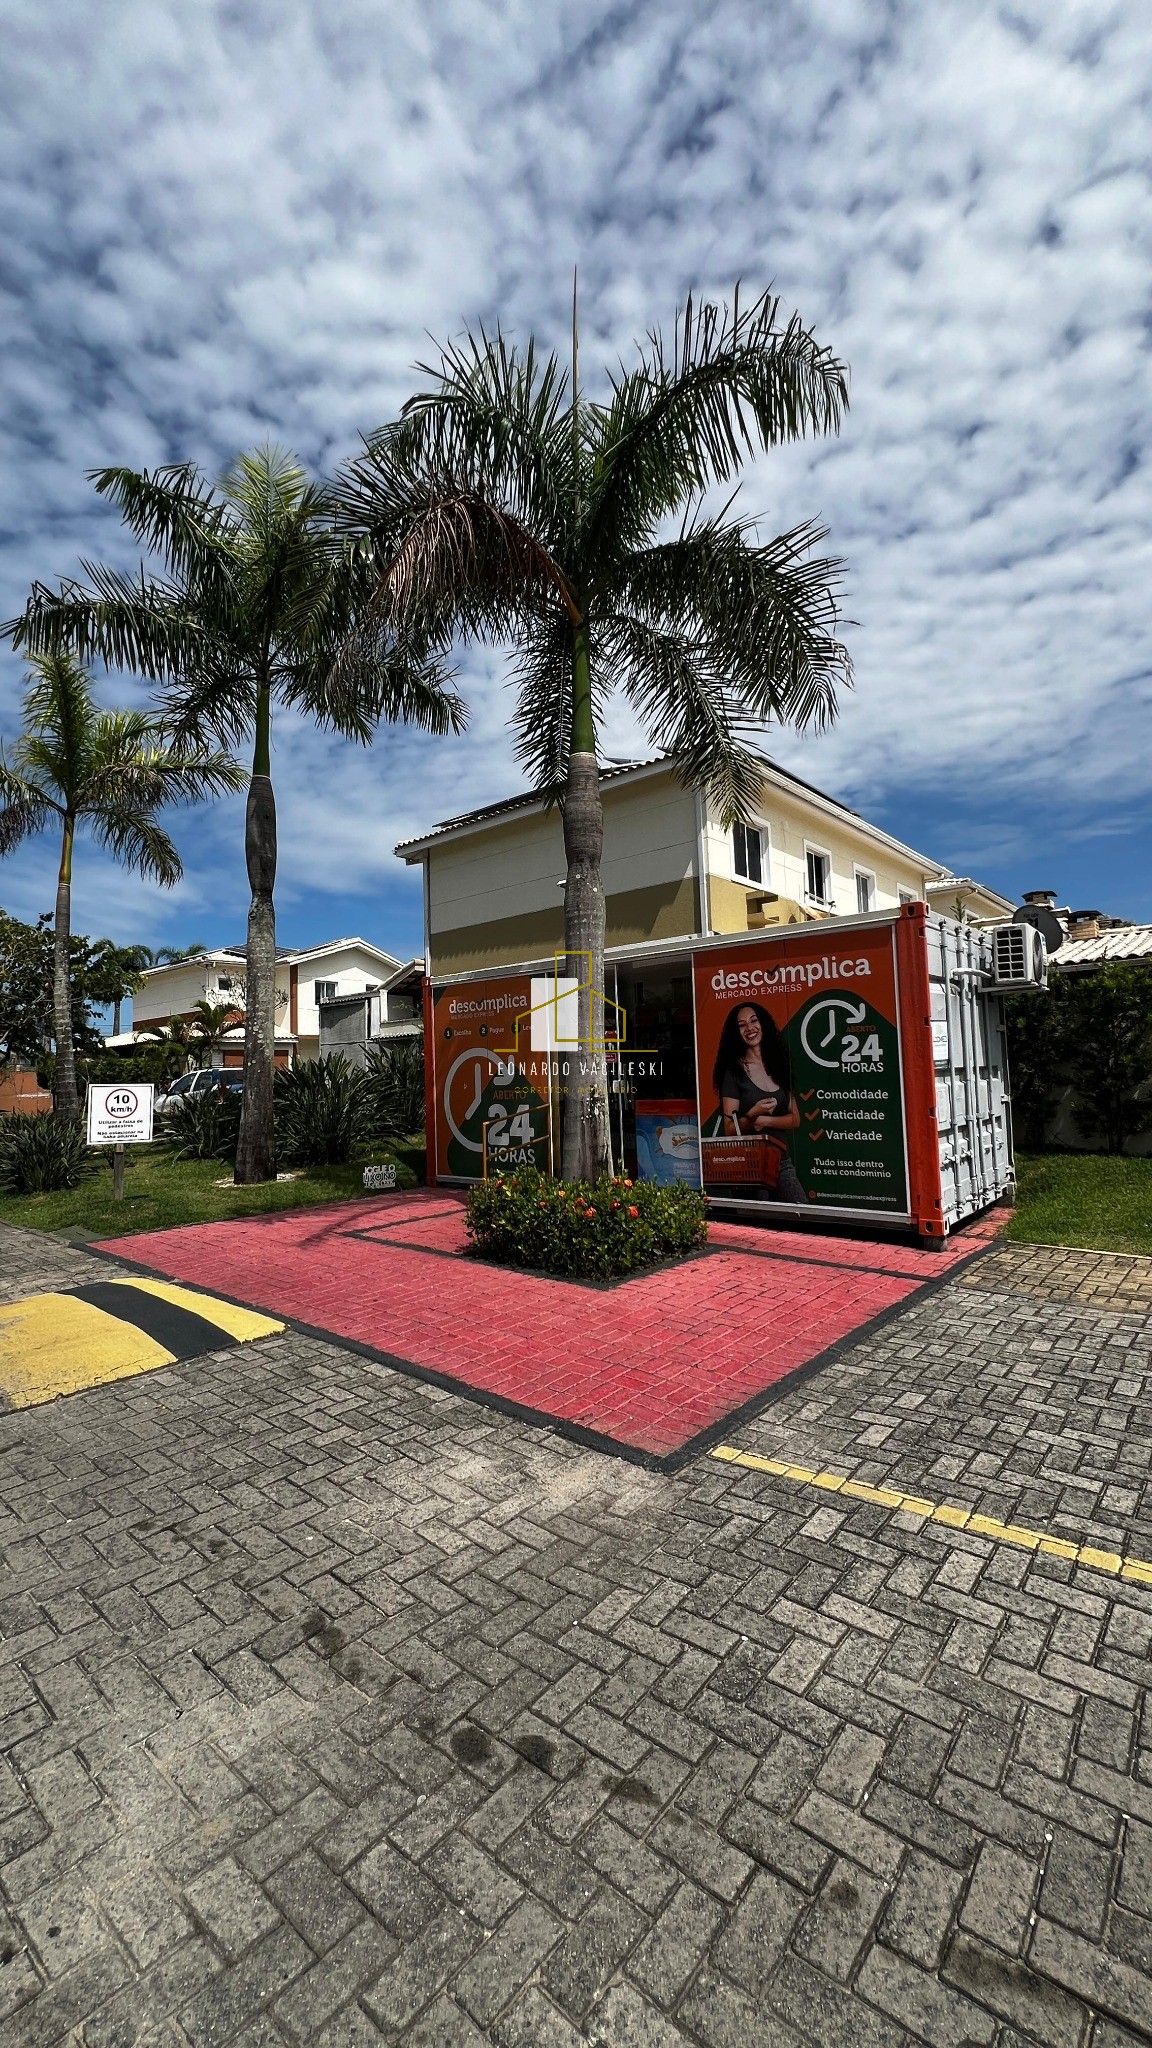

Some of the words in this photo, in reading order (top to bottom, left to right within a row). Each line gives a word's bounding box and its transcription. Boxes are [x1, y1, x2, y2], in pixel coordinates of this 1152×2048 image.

[711, 956, 872, 990] descomplica
[715, 988, 758, 1000] MERCADO
[760, 983, 802, 995] EXPRESS
[449, 994, 528, 1014] descomplica
[846, 1024, 876, 1033] ABERTO
[841, 1034, 884, 1063] 24
[841, 1062, 884, 1073] HORAS
[113, 1094, 130, 1104] 10
[492, 1090, 528, 1101] ABERTO
[816, 1089, 889, 1100] Comodidade
[821, 1109, 885, 1120] Praticidade
[487, 1103, 535, 1146] 24
[825, 1130, 882, 1141] Variedade
[487, 1146, 536, 1165] HORAS
[814, 1157, 835, 1166] Tudo
[837, 1159, 854, 1167] isso
[855, 1160, 884, 1169] dentro
[810, 1167, 821, 1175] do
